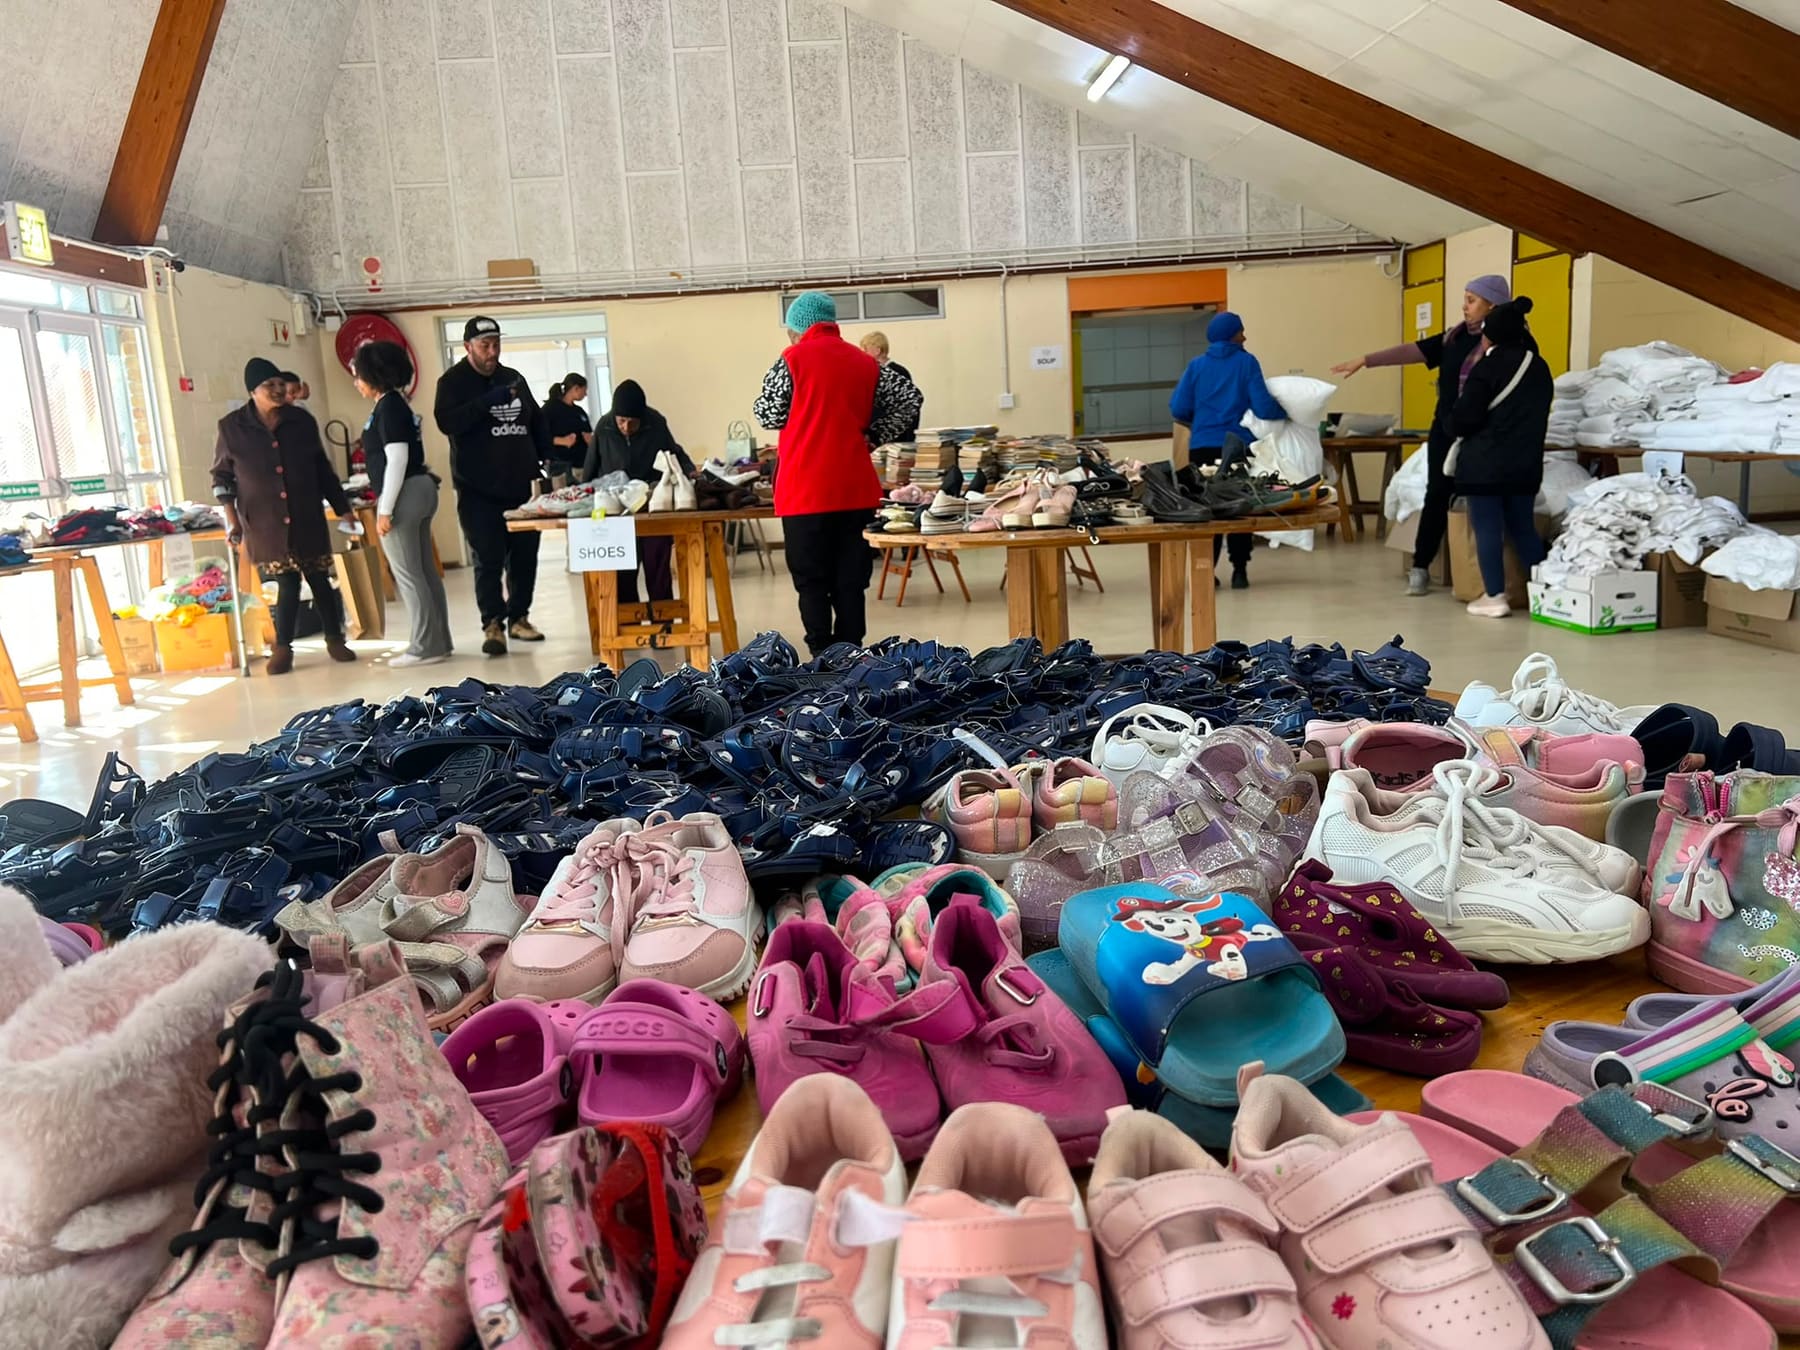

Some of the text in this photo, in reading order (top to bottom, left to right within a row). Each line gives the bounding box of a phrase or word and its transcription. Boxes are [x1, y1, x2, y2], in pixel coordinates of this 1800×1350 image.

[17, 215, 47, 249] EXIT
[491, 422, 528, 437] adidas
[578, 545, 626, 559] SHOES
